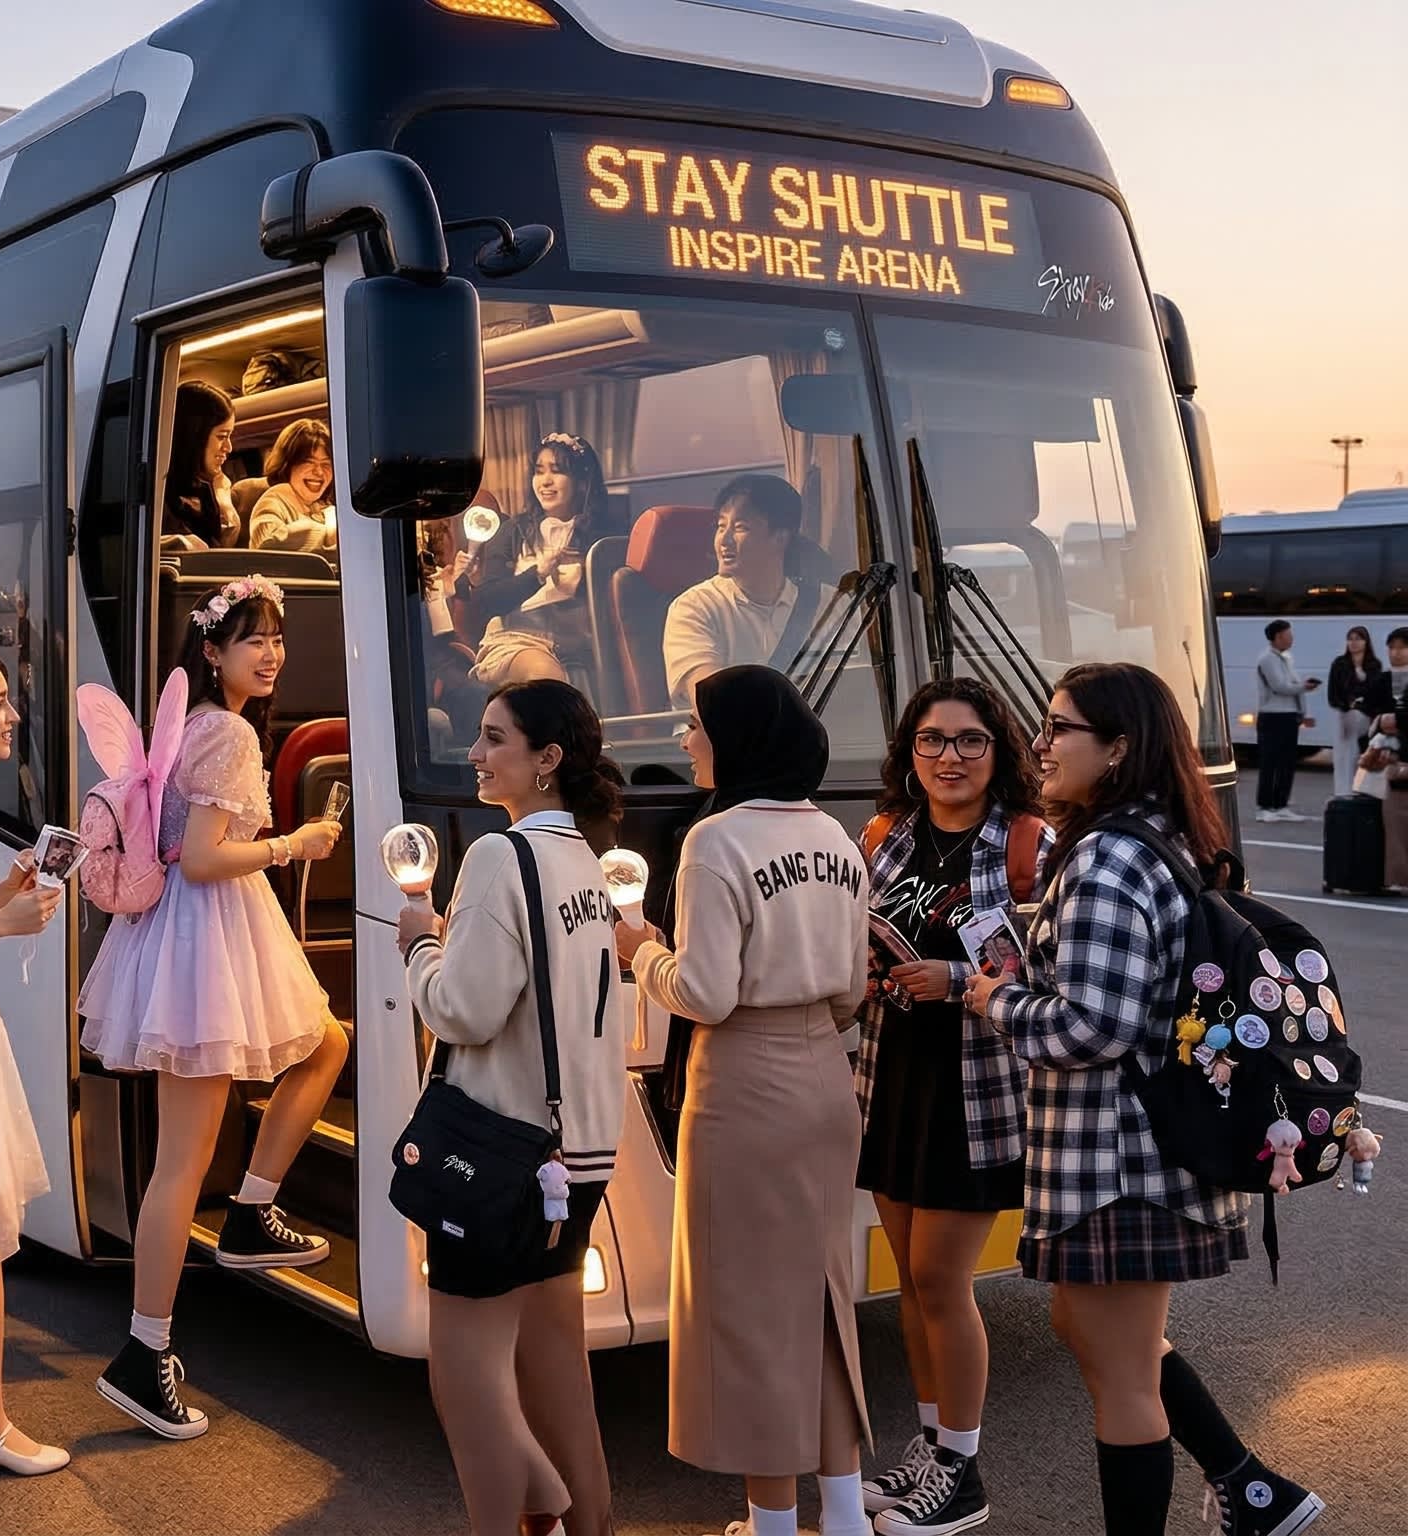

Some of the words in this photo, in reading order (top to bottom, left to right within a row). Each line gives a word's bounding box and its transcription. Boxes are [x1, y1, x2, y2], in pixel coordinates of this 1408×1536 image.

[586, 145, 750, 221] STAY
[770, 166, 1013, 255] SHUTTLE
[670, 226, 824, 280] INSPIRE
[836, 245, 961, 295] ARENA
[753, 852, 809, 901] BANG
[813, 851, 862, 900] CHAN
[558, 888, 598, 936] BANG
[594, 947, 610, 1038] 1
